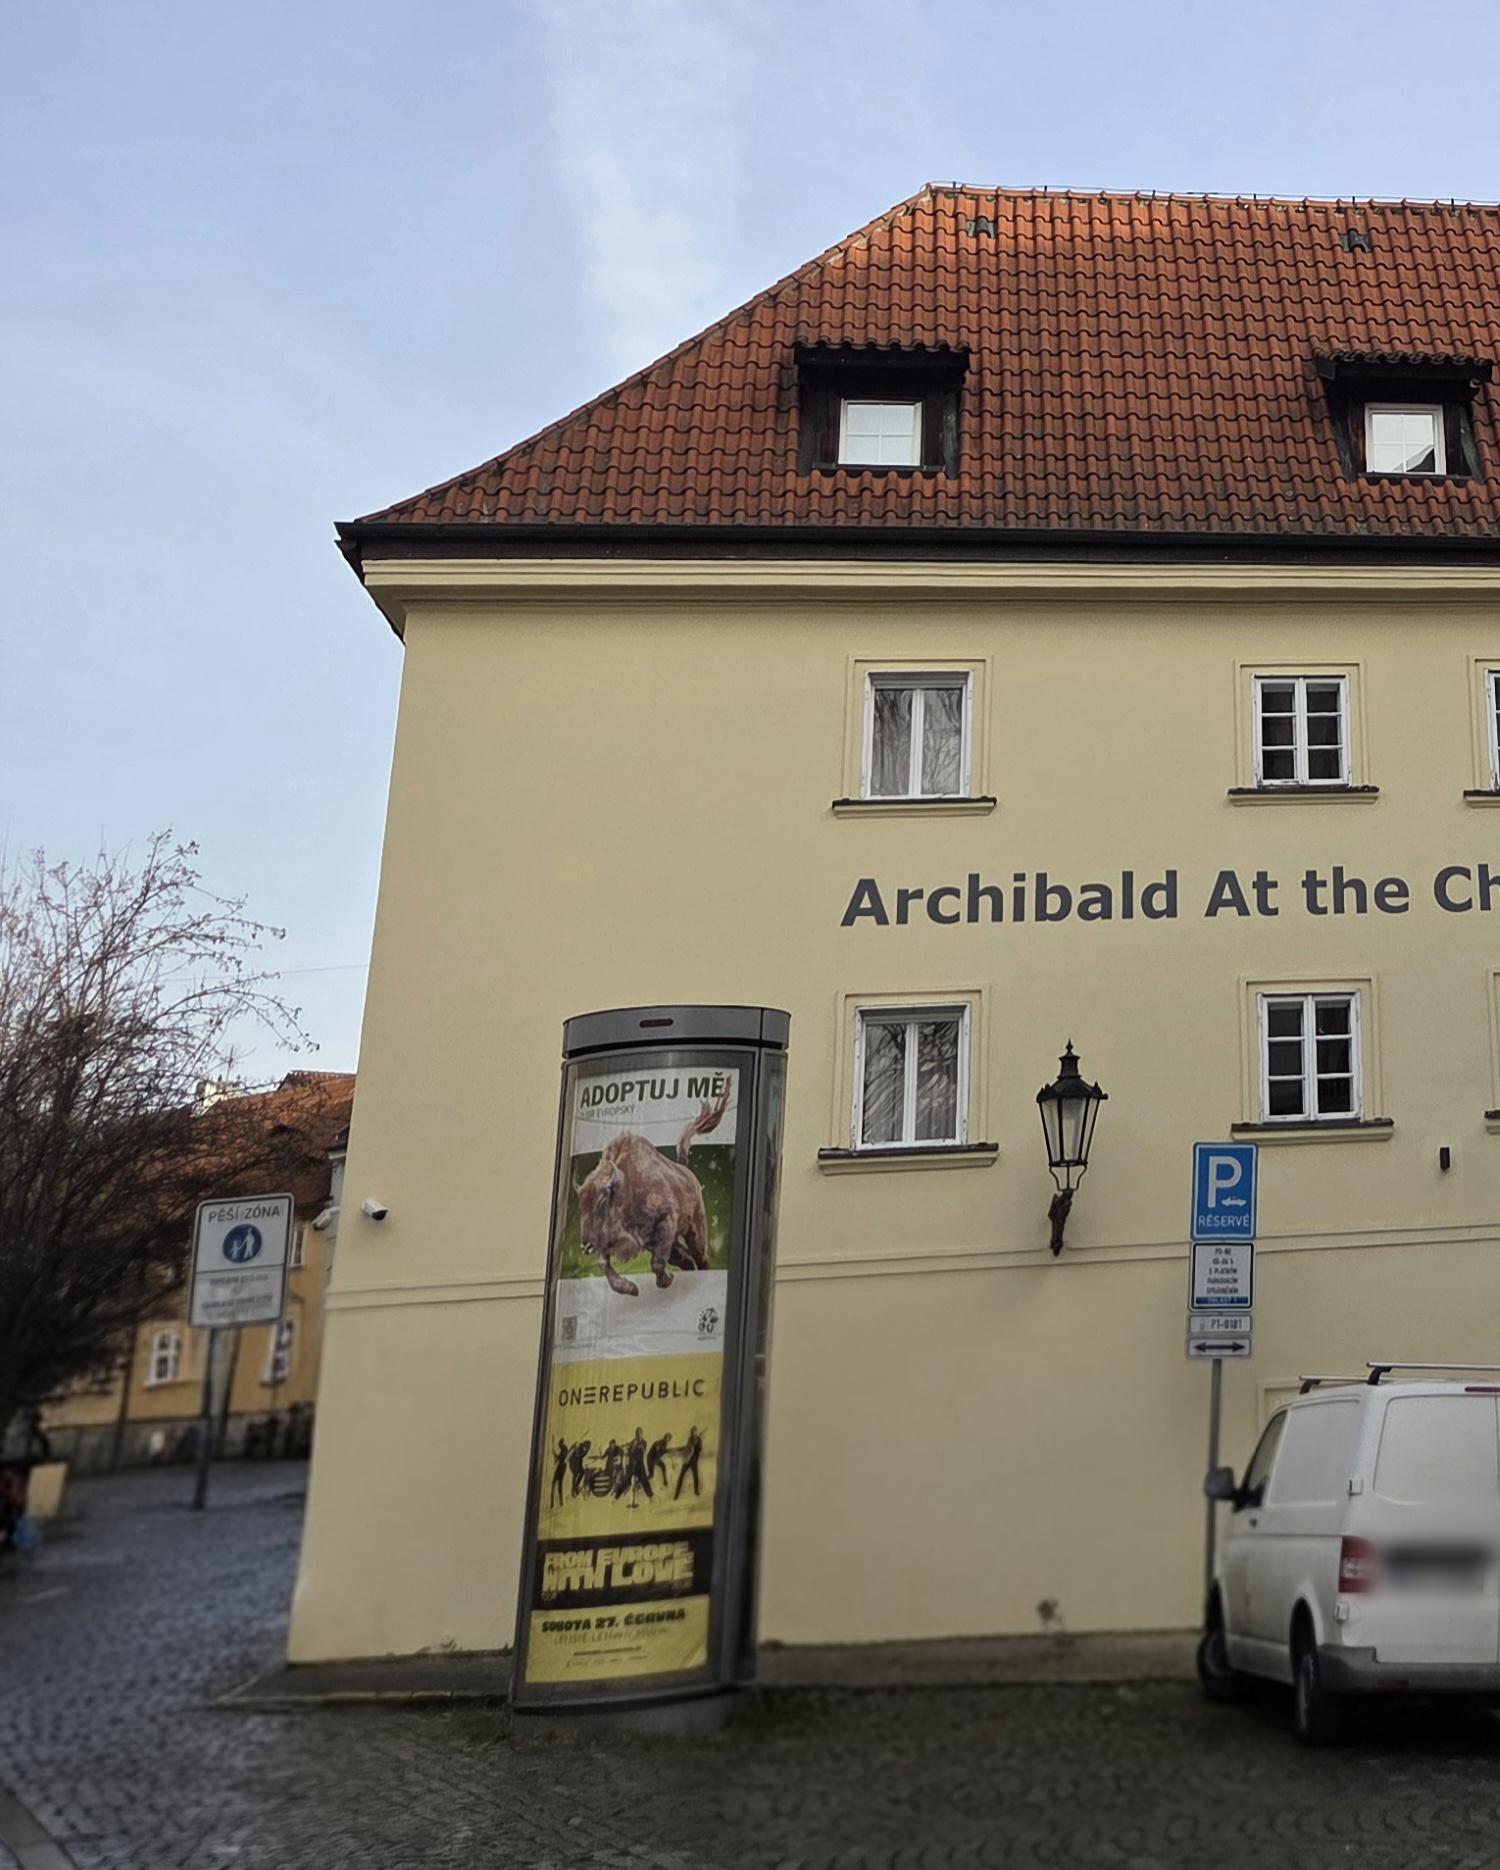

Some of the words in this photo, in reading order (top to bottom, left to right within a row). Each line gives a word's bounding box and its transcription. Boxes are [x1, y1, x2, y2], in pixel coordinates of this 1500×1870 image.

[840, 869, 1178, 927] Archibald
[1203, 870, 1279, 918] At
[1301, 866, 1410, 915] the
[579, 1077, 680, 1109] ADOPTUJ
[687, 1072, 726, 1099] MĚ
[1207, 1156, 1242, 1208] P
[244, 1203, 281, 1220] ZÓNA
[1198, 1212, 1250, 1228] RÉSERVÉ
[558, 1379, 706, 1407] ONEREPUBLIC
[541, 1618, 592, 1633] SOBOTA
[594, 1617, 620, 1630] 27.
